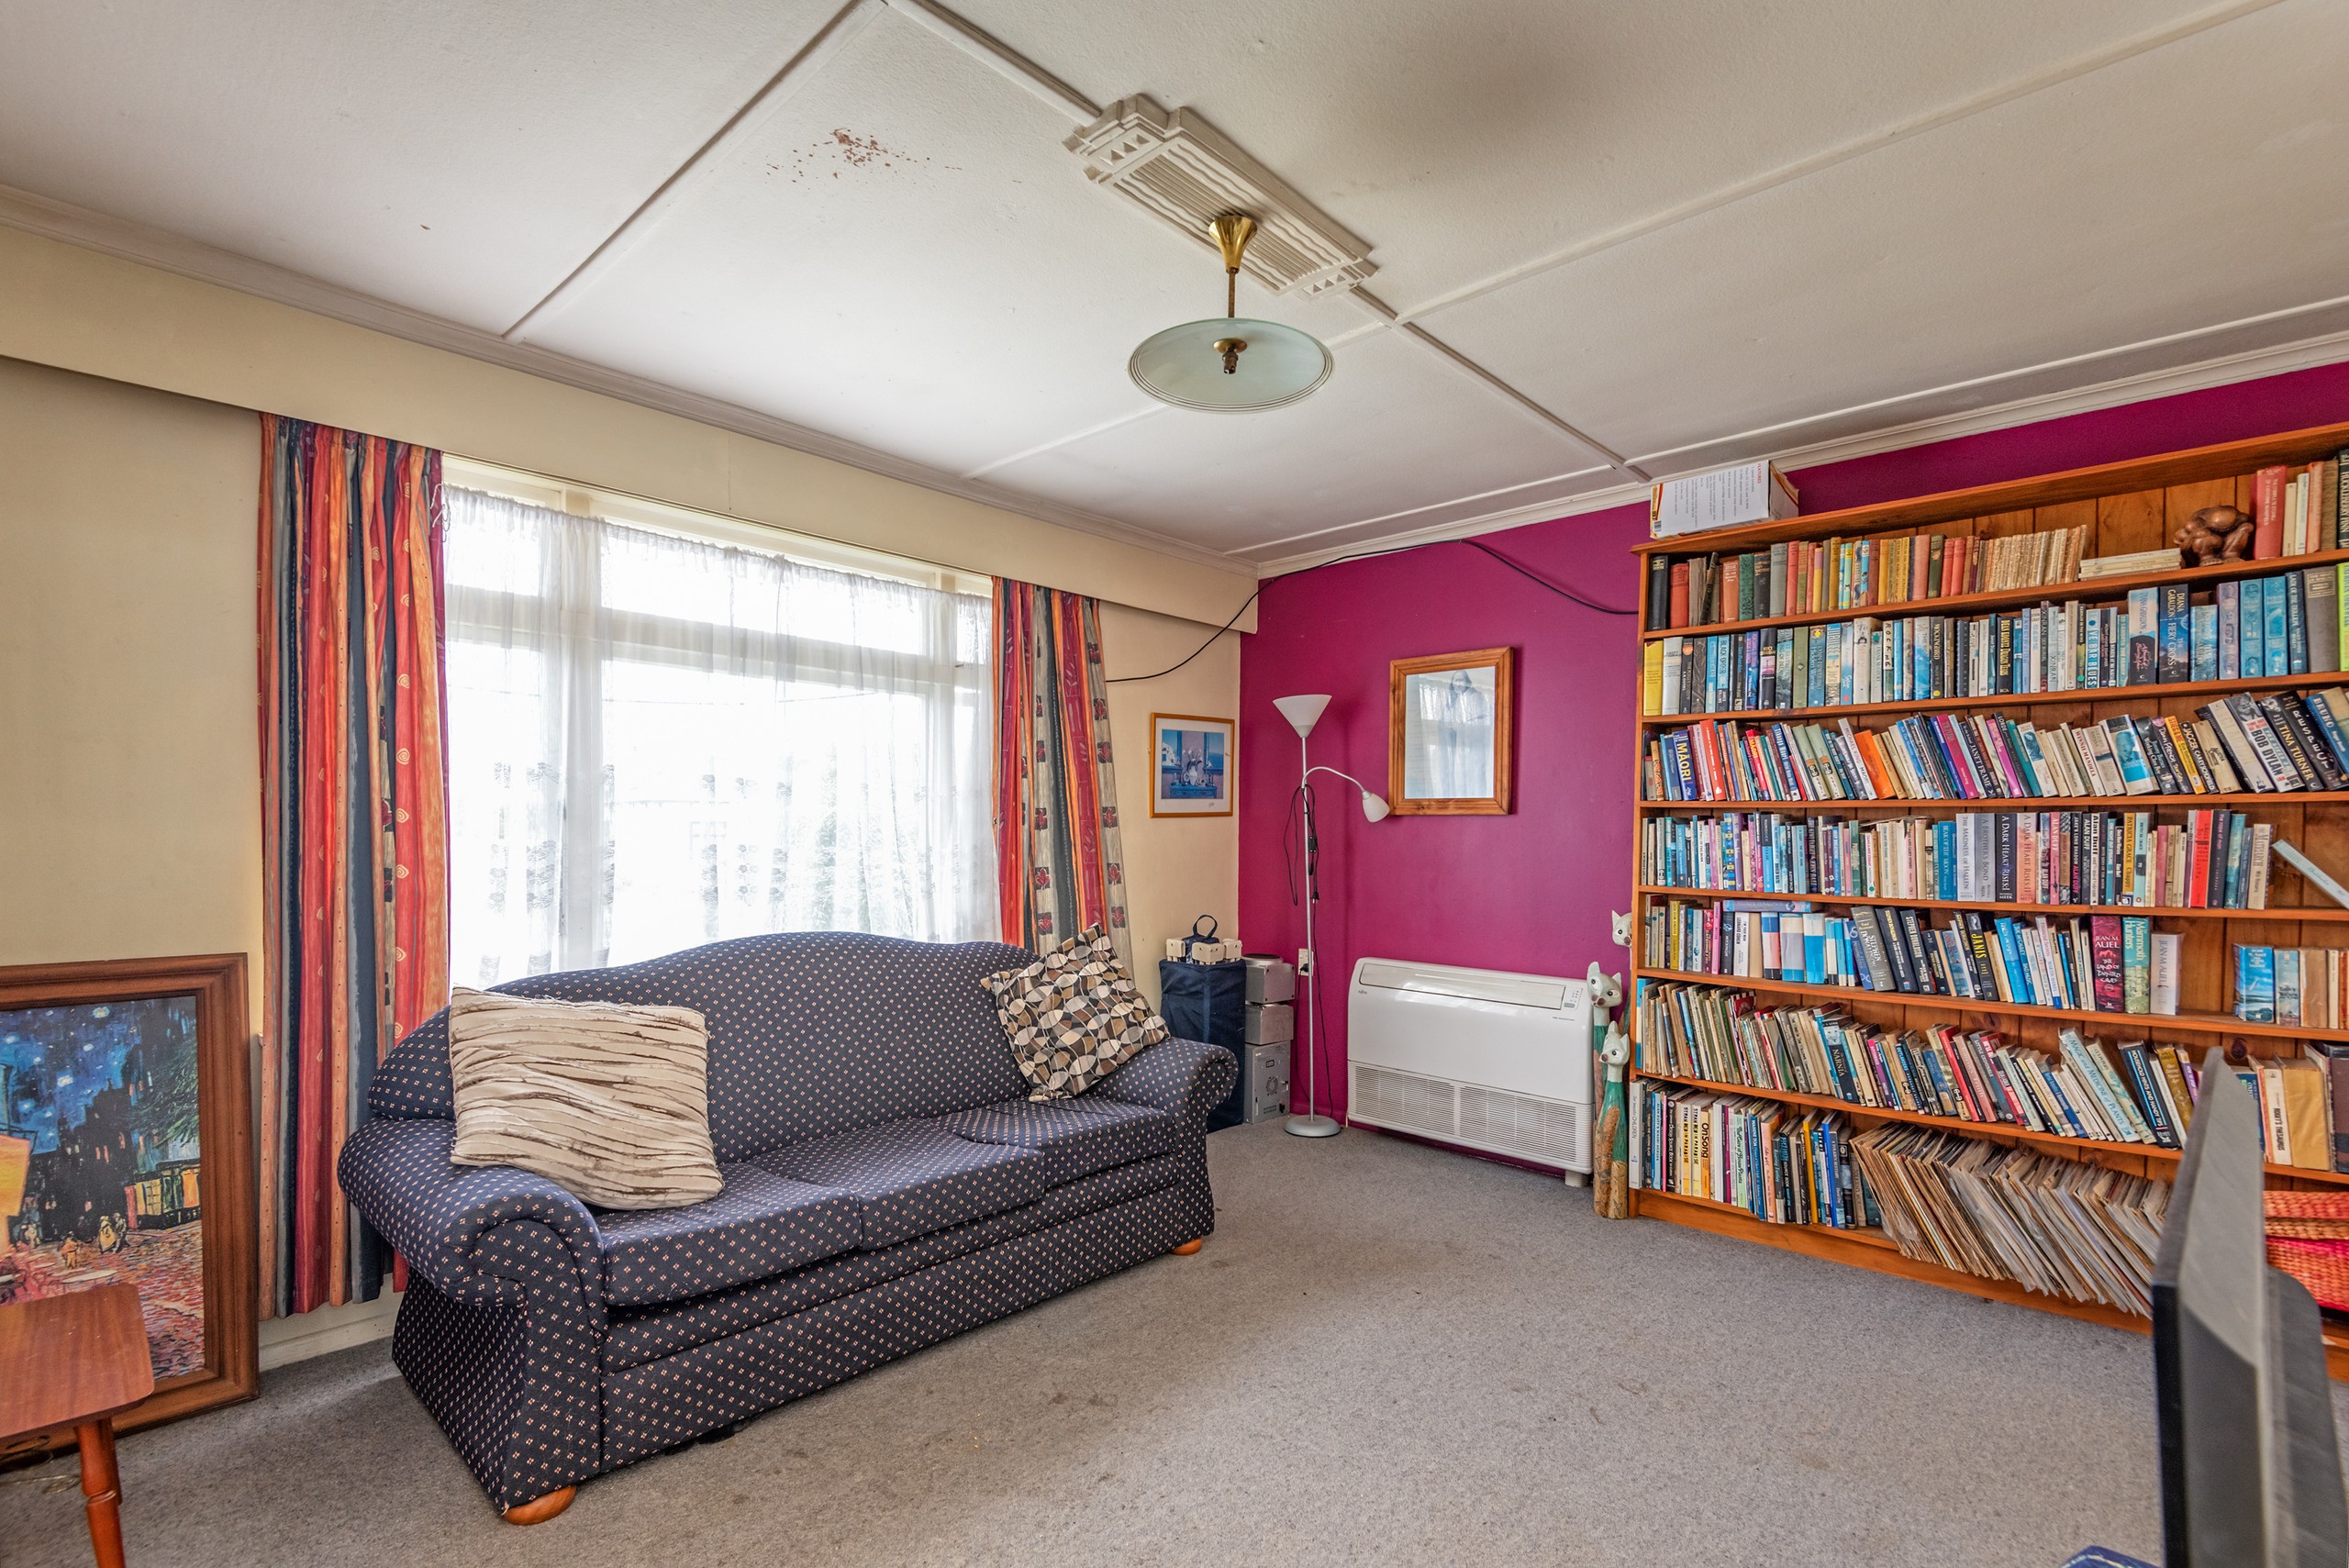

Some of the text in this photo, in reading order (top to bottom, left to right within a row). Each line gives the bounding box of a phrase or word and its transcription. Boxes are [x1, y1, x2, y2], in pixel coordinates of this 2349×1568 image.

[2167, 589, 2176, 617] GABALDON
[2176, 593, 2185, 612] DIANA
[2167, 622, 2176, 665] FIERY CROSS
[2313, 697, 2335, 728] BRUNO
[1844, 728, 1856, 750] MICHAEL
[2183, 728, 2199, 750] JAGGER
[2251, 729, 2284, 776] BOB DYLAN
[2278, 725, 2314, 781] TINA TURNER
[2292, 710, 2328, 768] RESPECT
[1970, 745, 1982, 764] JANET
[1978, 765, 1991, 788] FRAME
[2001, 823, 2009, 842] DARK
[1971, 933, 1987, 959] JANIS
[2125, 920, 2135, 949] Hunters
[2135, 920, 2145, 960] Mammoth
[2158, 940, 2168, 956] JEAN
[1832, 1049, 1844, 1076] NARNIA
[2069, 1040, 2084, 1059] MAGIC
[2087, 1070, 2108, 1096] MEDICINE
[2109, 1103, 2125, 1126] PLANTS
[2132, 1050, 2144, 1076] HOUSEHOLD
[2141, 1076, 2150, 1090] HINTS
[2146, 1090, 2154, 1101] AND
[2155, 1117, 2164, 1127] TIPS
